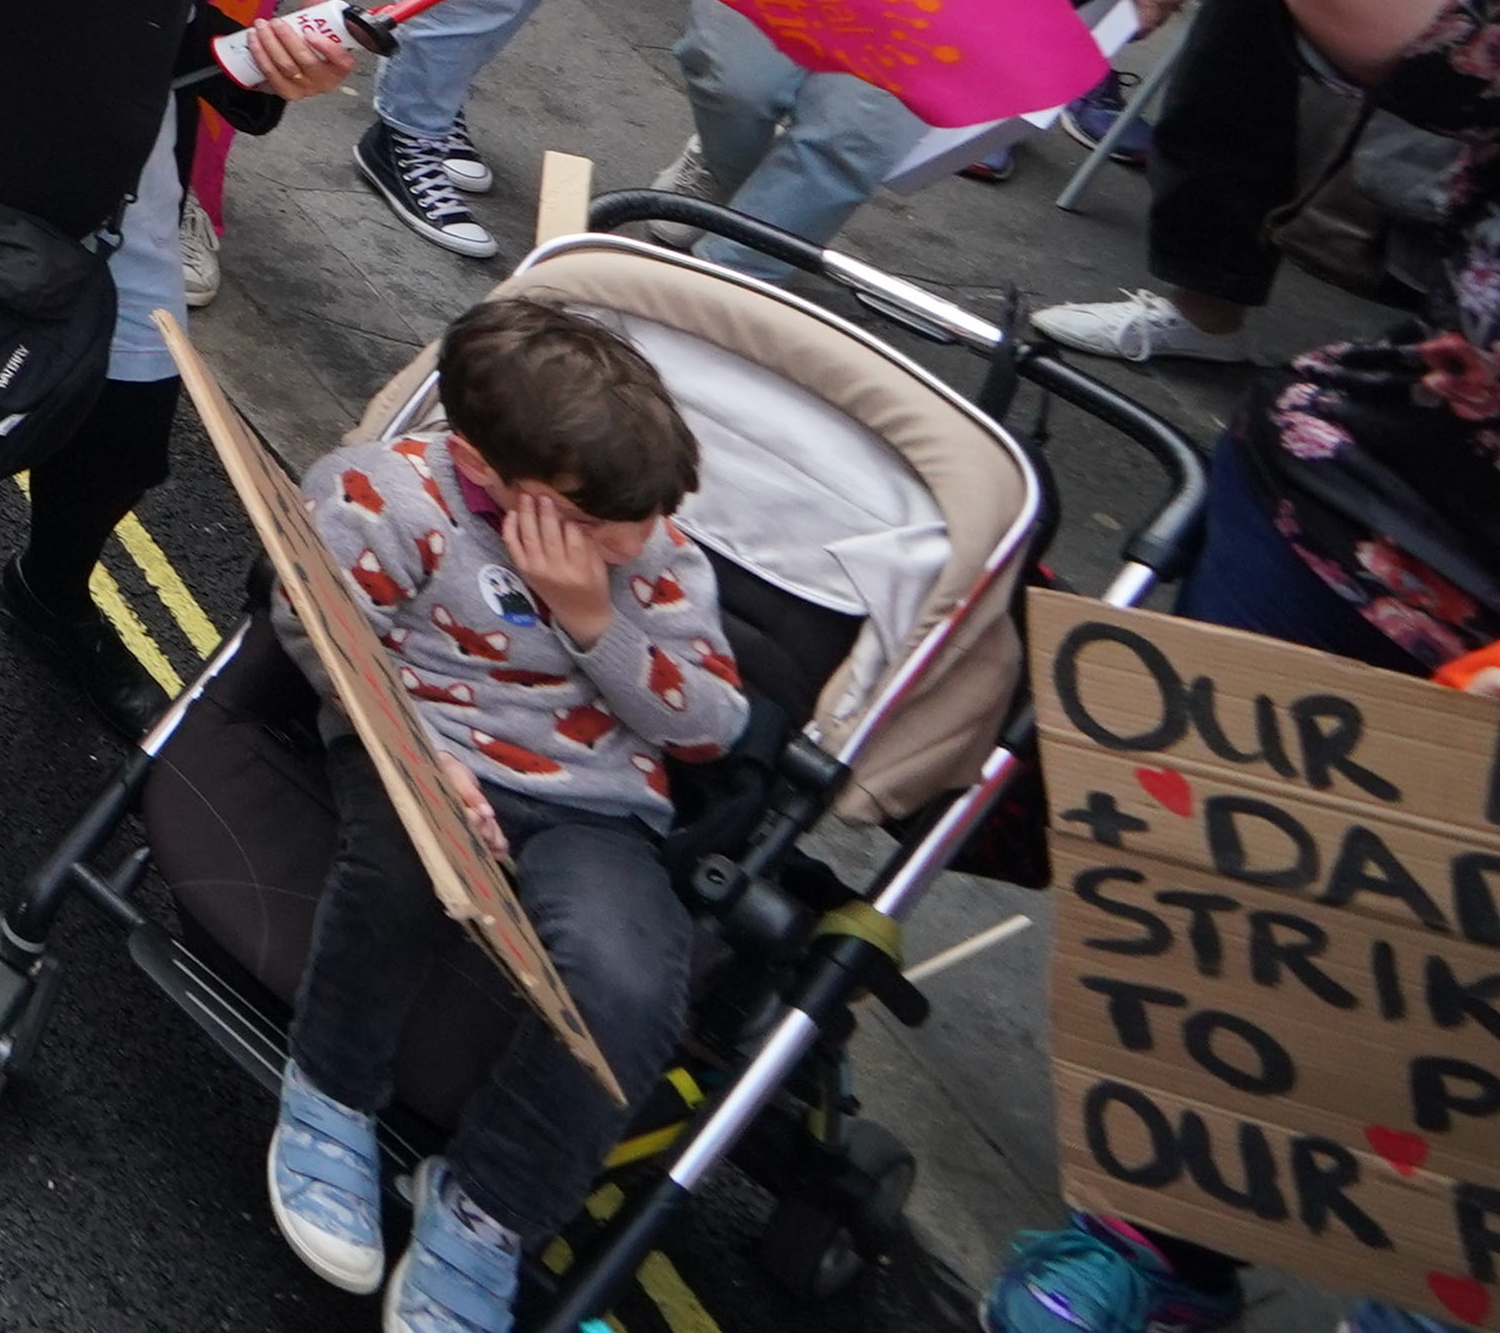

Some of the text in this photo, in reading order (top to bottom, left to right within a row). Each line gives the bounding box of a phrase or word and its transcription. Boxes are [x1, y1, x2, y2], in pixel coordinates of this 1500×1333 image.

[1052, 619, 1405, 805] OUR
[1076, 974, 1297, 1097] TO
[1084, 1080, 1397, 1252] OUR
